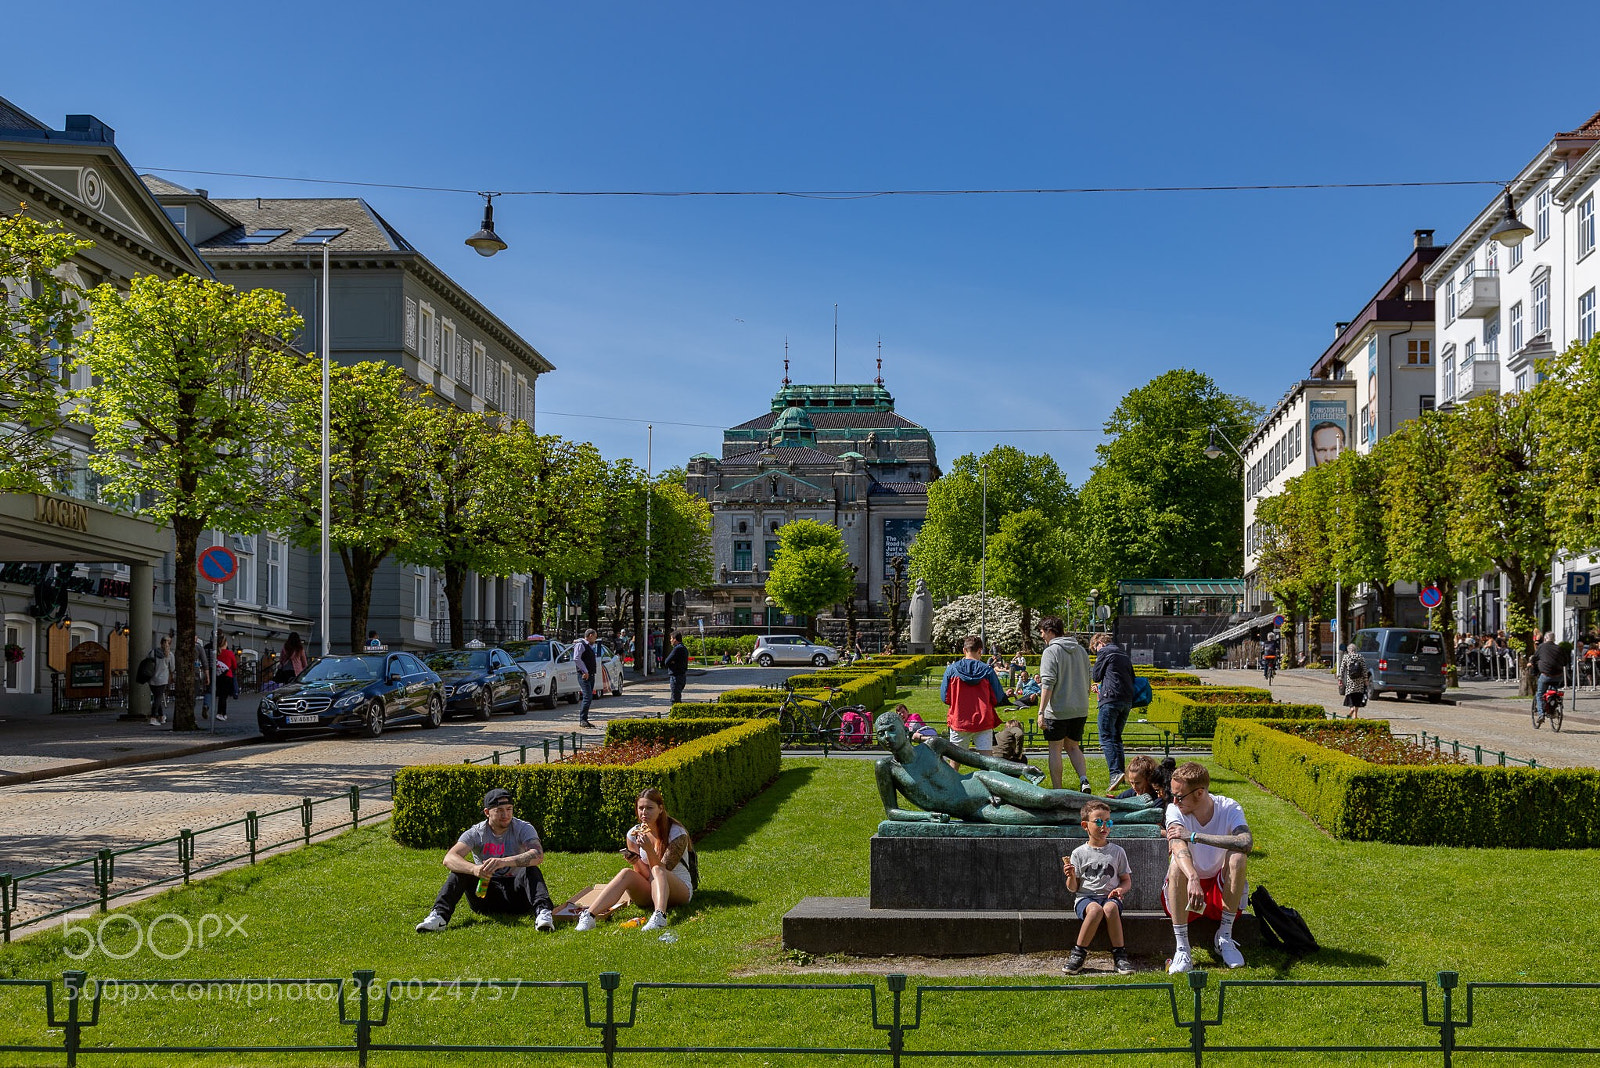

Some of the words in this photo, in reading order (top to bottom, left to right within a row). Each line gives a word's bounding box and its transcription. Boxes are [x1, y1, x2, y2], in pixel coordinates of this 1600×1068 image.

[34, 495, 89, 532] LOGEN
[1573, 575, 1585, 592] P
[483, 842, 505, 856] FRU
